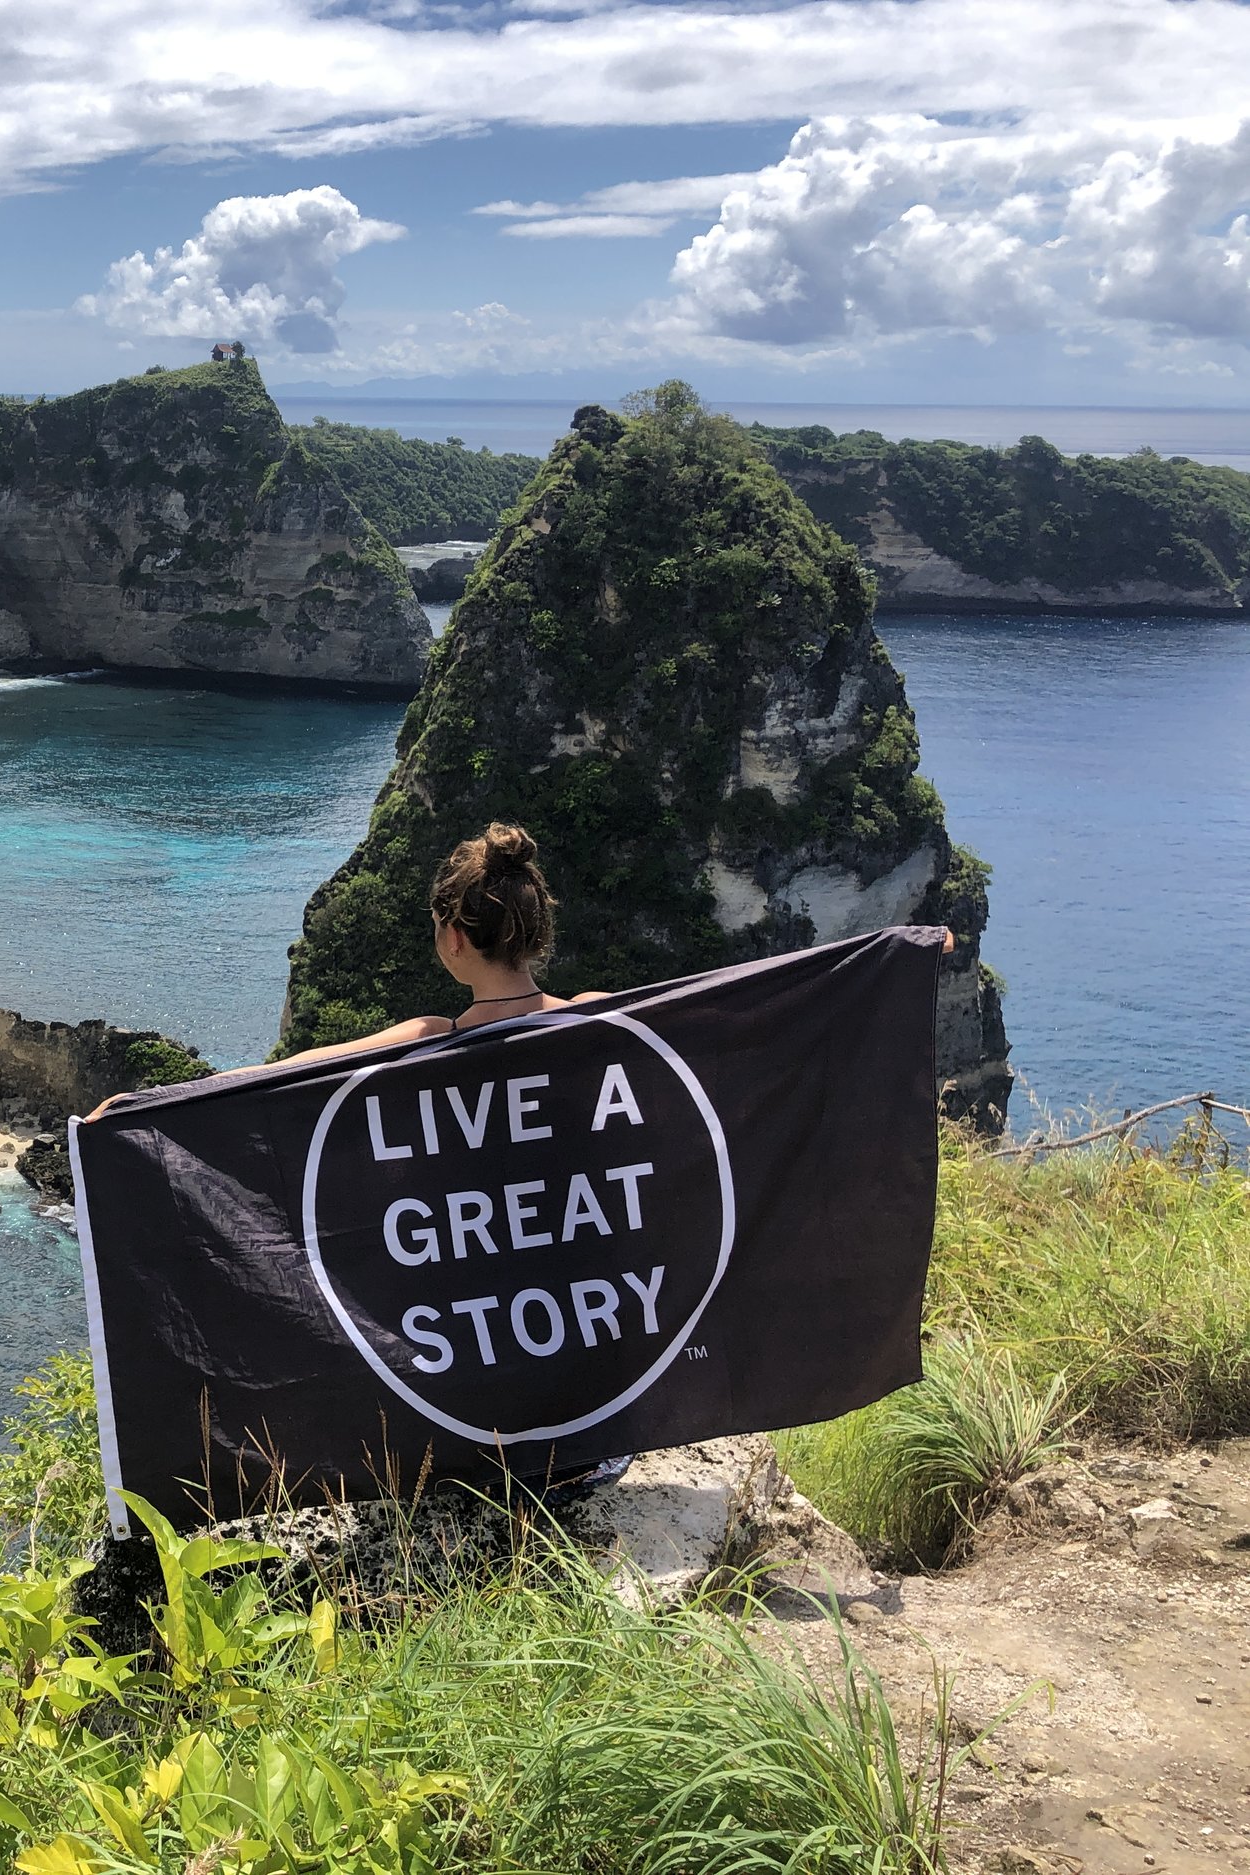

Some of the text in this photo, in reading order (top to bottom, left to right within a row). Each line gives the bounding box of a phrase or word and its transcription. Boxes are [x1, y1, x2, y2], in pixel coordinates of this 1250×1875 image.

[366, 1064, 644, 1160] LIVE A
[384, 1163, 654, 1266] GREAT
[402, 1266, 665, 1373] STORY
